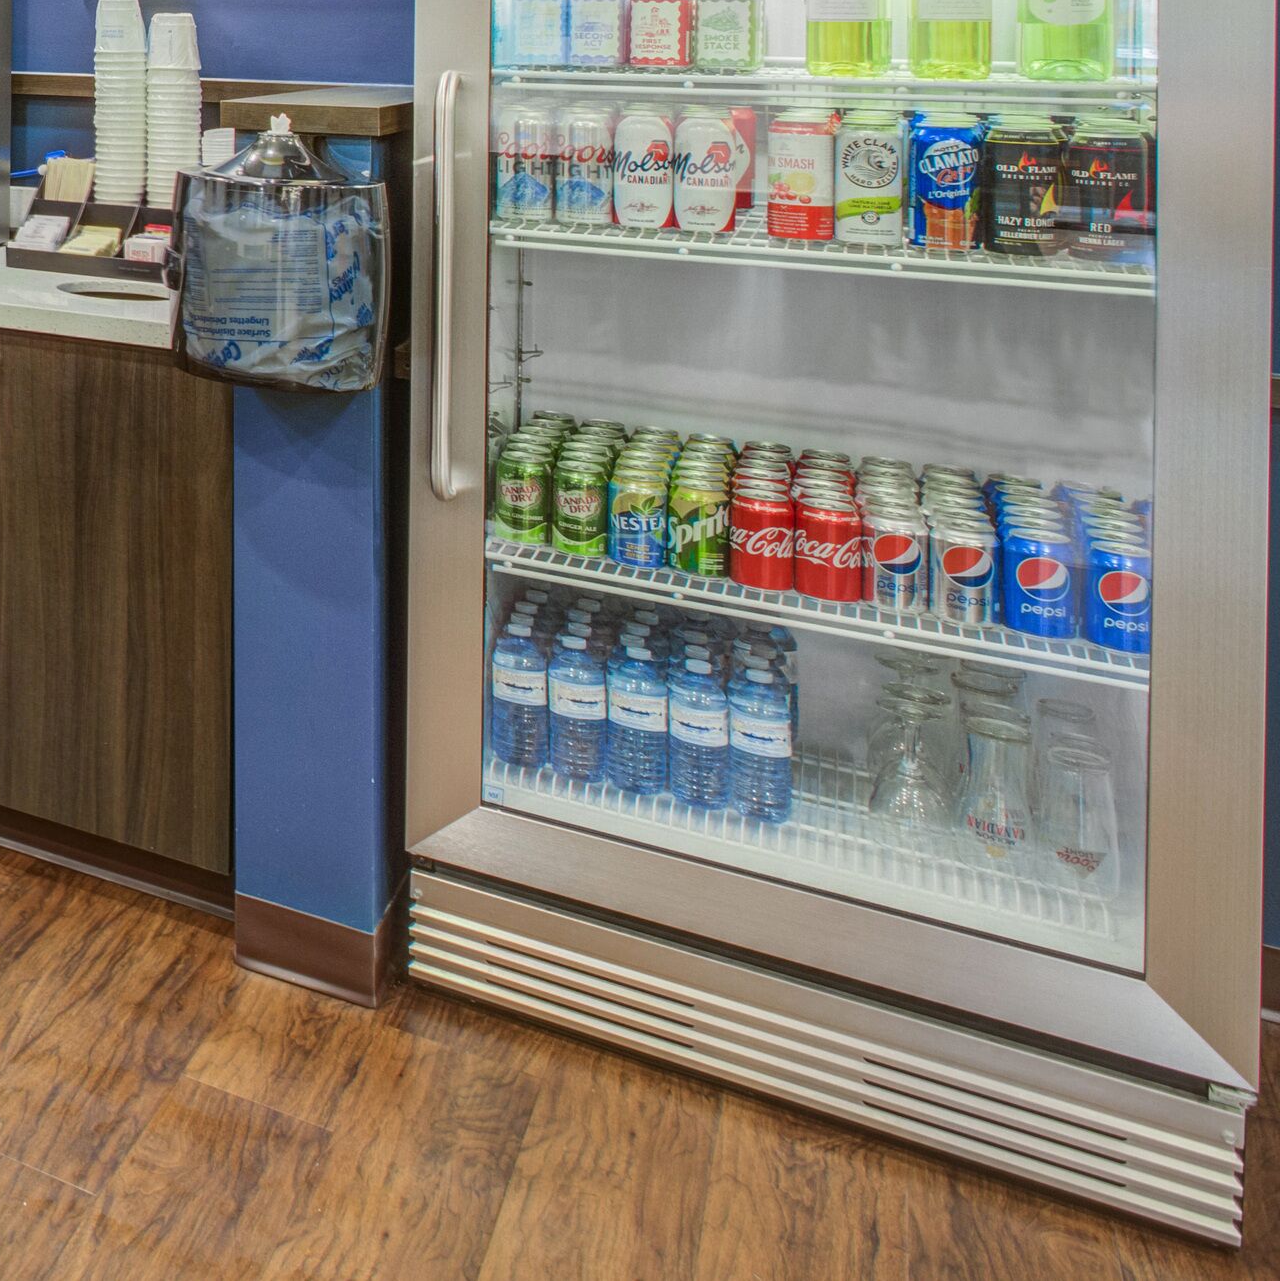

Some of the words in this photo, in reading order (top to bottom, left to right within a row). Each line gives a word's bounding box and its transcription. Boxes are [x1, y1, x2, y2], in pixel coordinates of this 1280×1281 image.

[574, 32, 614, 40] SECOND
[703, 34, 739, 42] SMOKE
[703, 42, 740, 50] STACK
[842, 139, 861, 169] WHITE
[863, 138, 897, 156] CLAW
[778, 158, 815, 170] SMASH
[918, 148, 980, 175] CLAMATO
[996, 163, 1019, 173] OLD
[1027, 165, 1057, 174] FLAME
[626, 172, 668, 185] CANADIAN
[1071, 169, 1090, 179] OLD
[1098, 171, 1138, 181] FLAME
[686, 176, 729, 188] CANADIAN
[928, 188, 971, 199] L'Original
[997, 215, 1022, 227] HAZY
[1089, 222, 1112, 234] RED
[502, 483, 540, 496] CANADA
[511, 493, 533, 503] DRY
[559, 493, 599, 507] CANADA
[569, 503, 592, 514] DRY
[558, 521, 583, 532] GINGER
[610, 513, 666, 532] NESTEA
[1020, 602, 1067, 618] pepsi
[1103, 617, 1150, 633] pepsi
